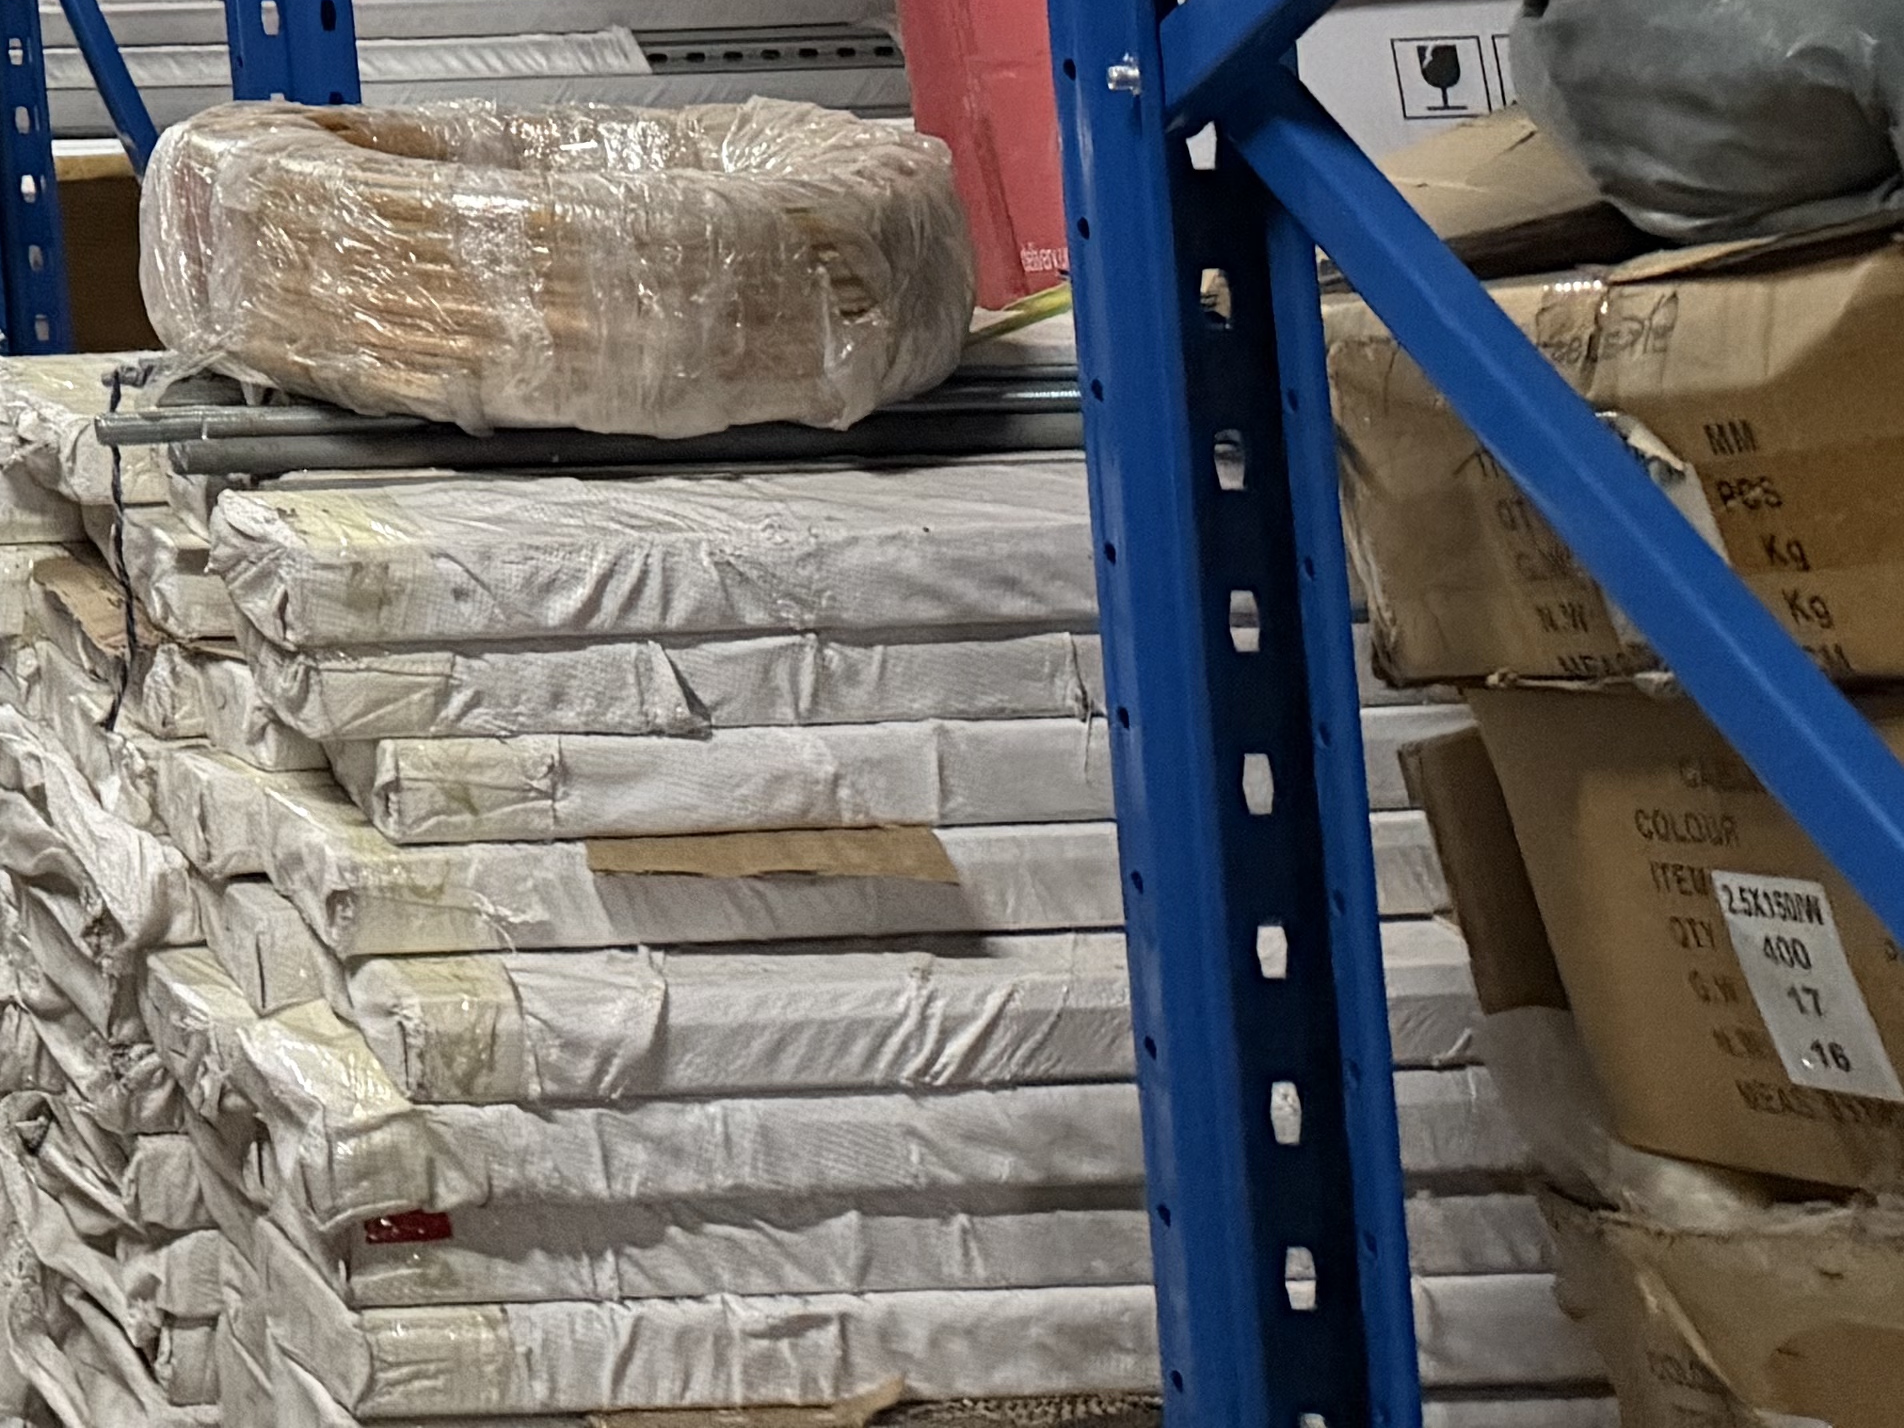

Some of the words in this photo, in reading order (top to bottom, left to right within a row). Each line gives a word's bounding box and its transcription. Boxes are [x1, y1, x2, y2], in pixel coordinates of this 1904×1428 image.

[1717, 476, 1783, 514] PCS
[1761, 534, 1811, 572] Kg
[1782, 589, 1834, 629] Kg
[1763, 935, 1812, 970] 400
[1788, 986, 1825, 1019] 17
[1809, 1039, 1851, 1073] 16
